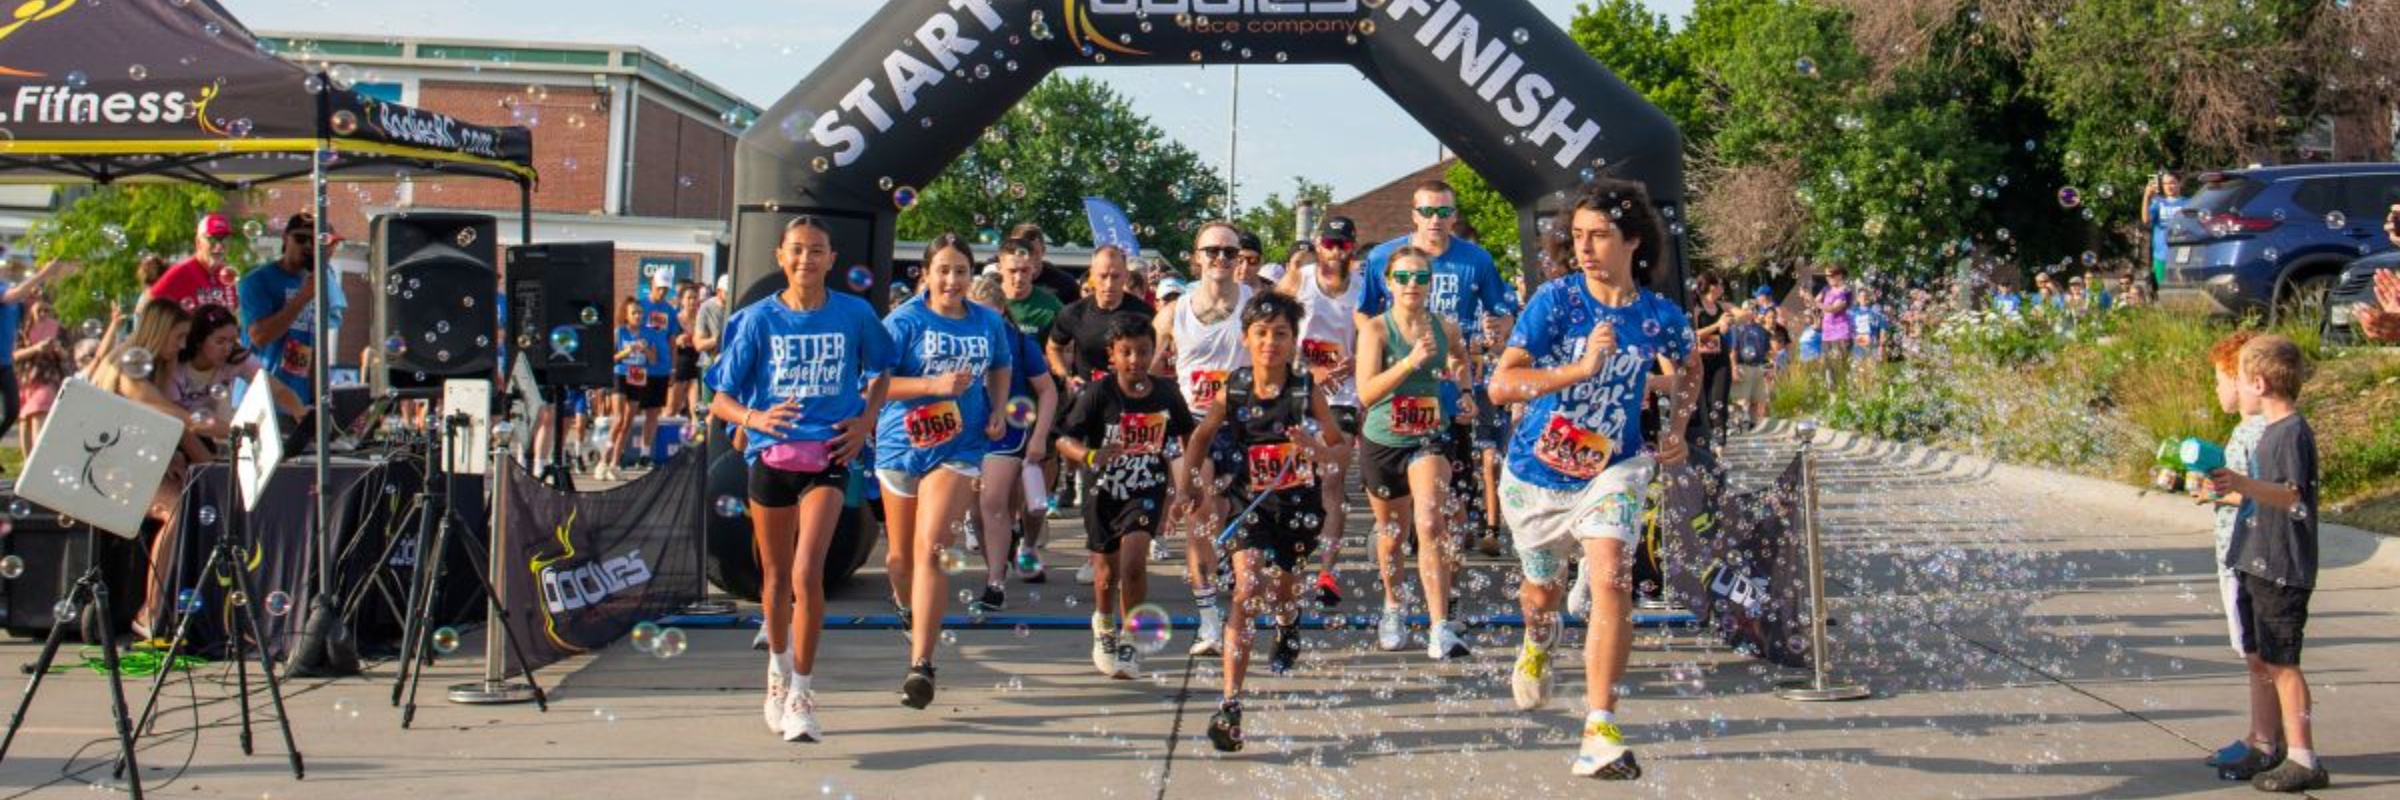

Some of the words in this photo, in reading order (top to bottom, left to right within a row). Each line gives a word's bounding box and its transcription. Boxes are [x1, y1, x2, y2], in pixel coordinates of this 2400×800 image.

[1247, 19, 1357, 34] company
[810, 0, 1003, 167] START
[770, 332, 845, 361] BETTER
[922, 330, 989, 358] BETTER
